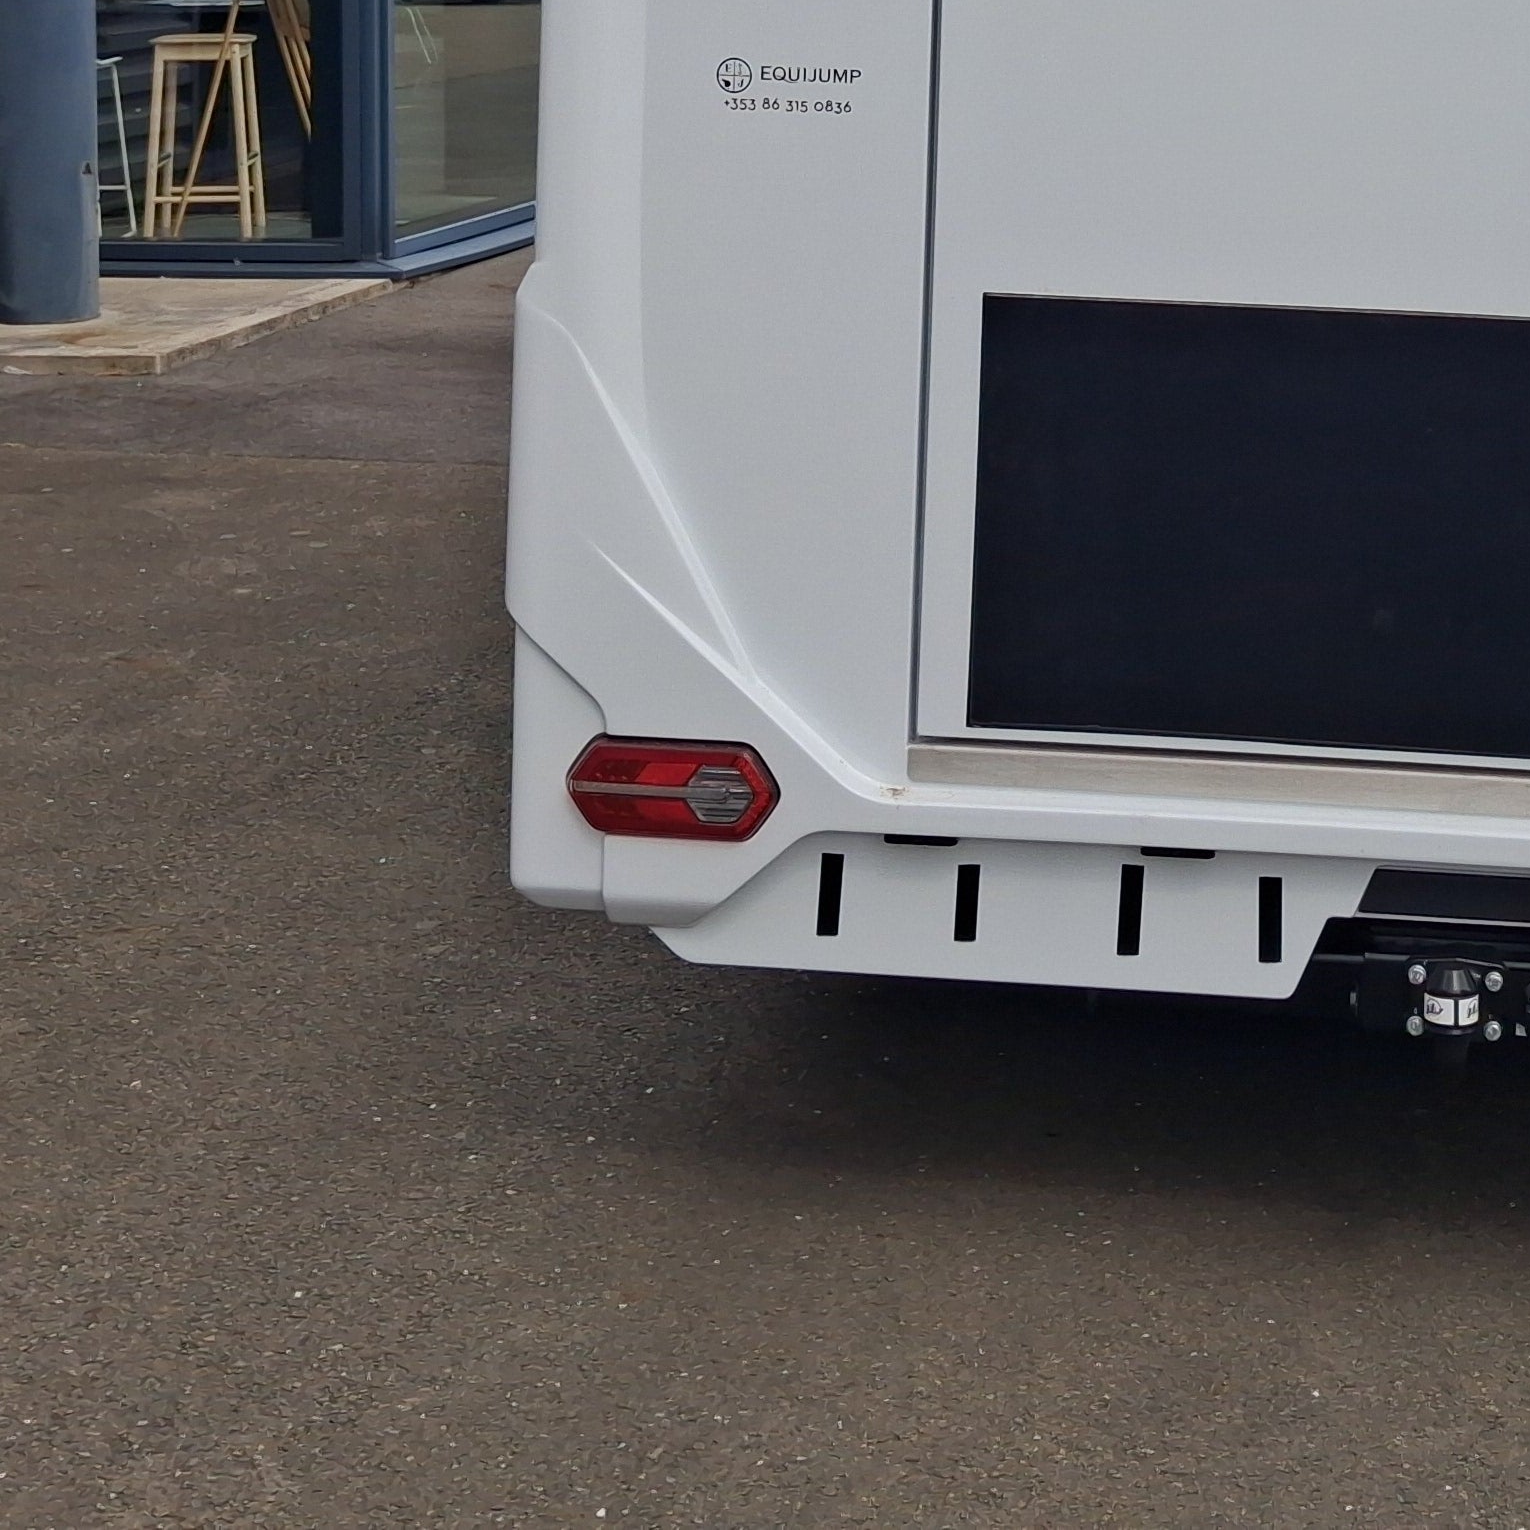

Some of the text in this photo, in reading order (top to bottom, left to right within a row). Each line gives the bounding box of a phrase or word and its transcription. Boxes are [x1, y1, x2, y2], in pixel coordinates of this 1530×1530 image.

[760, 65, 862, 84] EQUIJUMP
[724, 97, 852, 114] +353 86 315 0836
